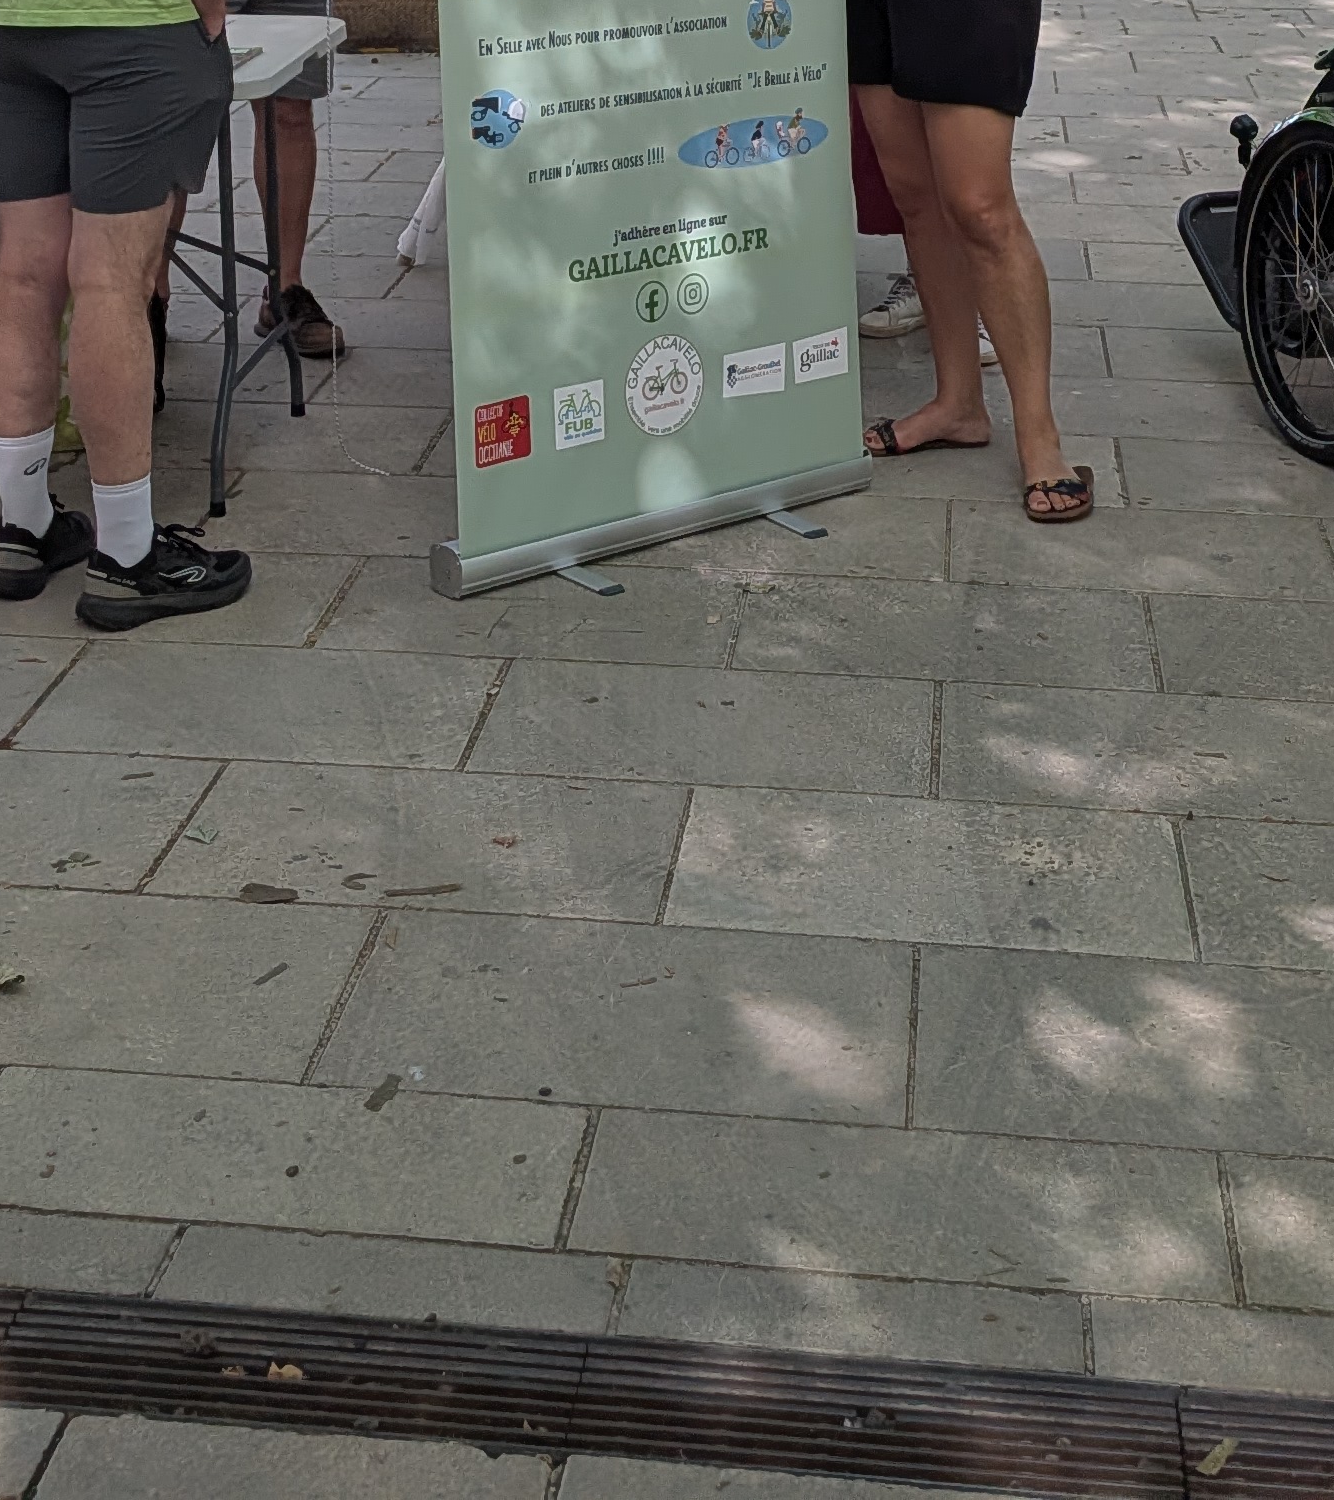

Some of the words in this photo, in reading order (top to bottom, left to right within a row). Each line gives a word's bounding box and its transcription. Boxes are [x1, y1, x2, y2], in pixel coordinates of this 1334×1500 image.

[478, 38, 493, 56] EN
[496, 37, 523, 54] SELLE
[525, 37, 547, 52] AVEC
[548, 30, 572, 48] NOUS
[575, 31, 600, 44] POUR
[603, 23, 663, 41] PROMOUVOIR
[666, 16, 727, 34] L'ASSOCIATION
[540, 104, 555, 117] DES
[558, 100, 596, 114] ATELIERS
[599, 96, 610, 109] DE
[613, 88, 683, 107] SENSIBILISATION
[685, 81, 692, 97] À
[694, 84, 704, 96] LA
[706, 74, 742, 95] SÉCURITÉ
[764, 70, 790, 87] BRILLE
[793, 67, 800, 83] À
[528, 171, 537, 184] ET
[539, 167, 562, 182] PLEIN
[565, 158, 609, 178] D'AUTRES
[612, 154, 644, 171] CHOSES
[613, 225, 660, 247] j'adhère
[662, 222, 677, 235] en
[678, 218, 707, 234] ligne
[709, 214, 728, 227] sur
[568, 227, 769, 282] GAILLACAVELO.FR
[627, 336, 701, 389] GAILLACAVELO
[800, 348, 840, 373] gaillac
[477, 422, 497, 443] VÉLO
[564, 418, 594, 434] FUB
